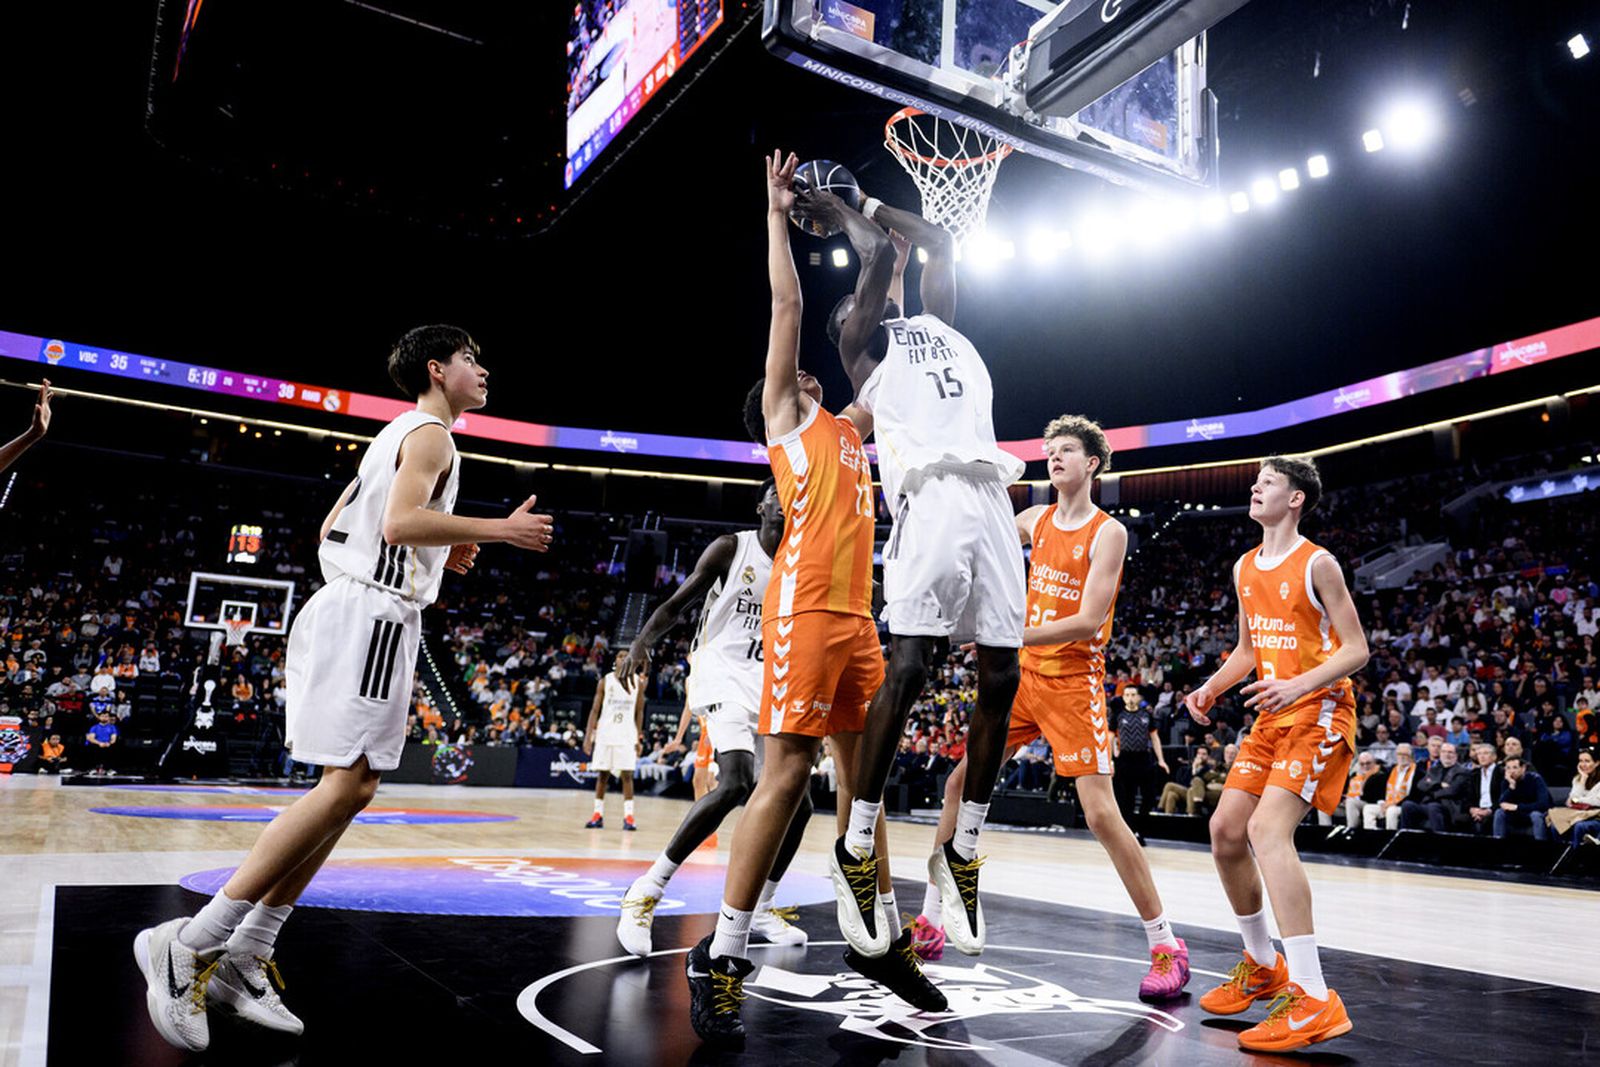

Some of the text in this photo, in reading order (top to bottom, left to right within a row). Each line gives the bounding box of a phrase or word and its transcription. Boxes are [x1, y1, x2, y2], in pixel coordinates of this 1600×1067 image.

[803, 60, 943, 115] MINICOPA endesa
[953, 115, 1025, 149] MINICOPA
[79, 350, 98, 364] VBC
[110, 353, 129, 370] 35
[187, 367, 217, 387] 5:19
[908, 347, 927, 364] FLY
[925, 366, 964, 400] 15
[1031, 561, 1070, 584] ultura
[743, 616, 761, 630] FLY
[1246, 612, 1284, 633] ultura
